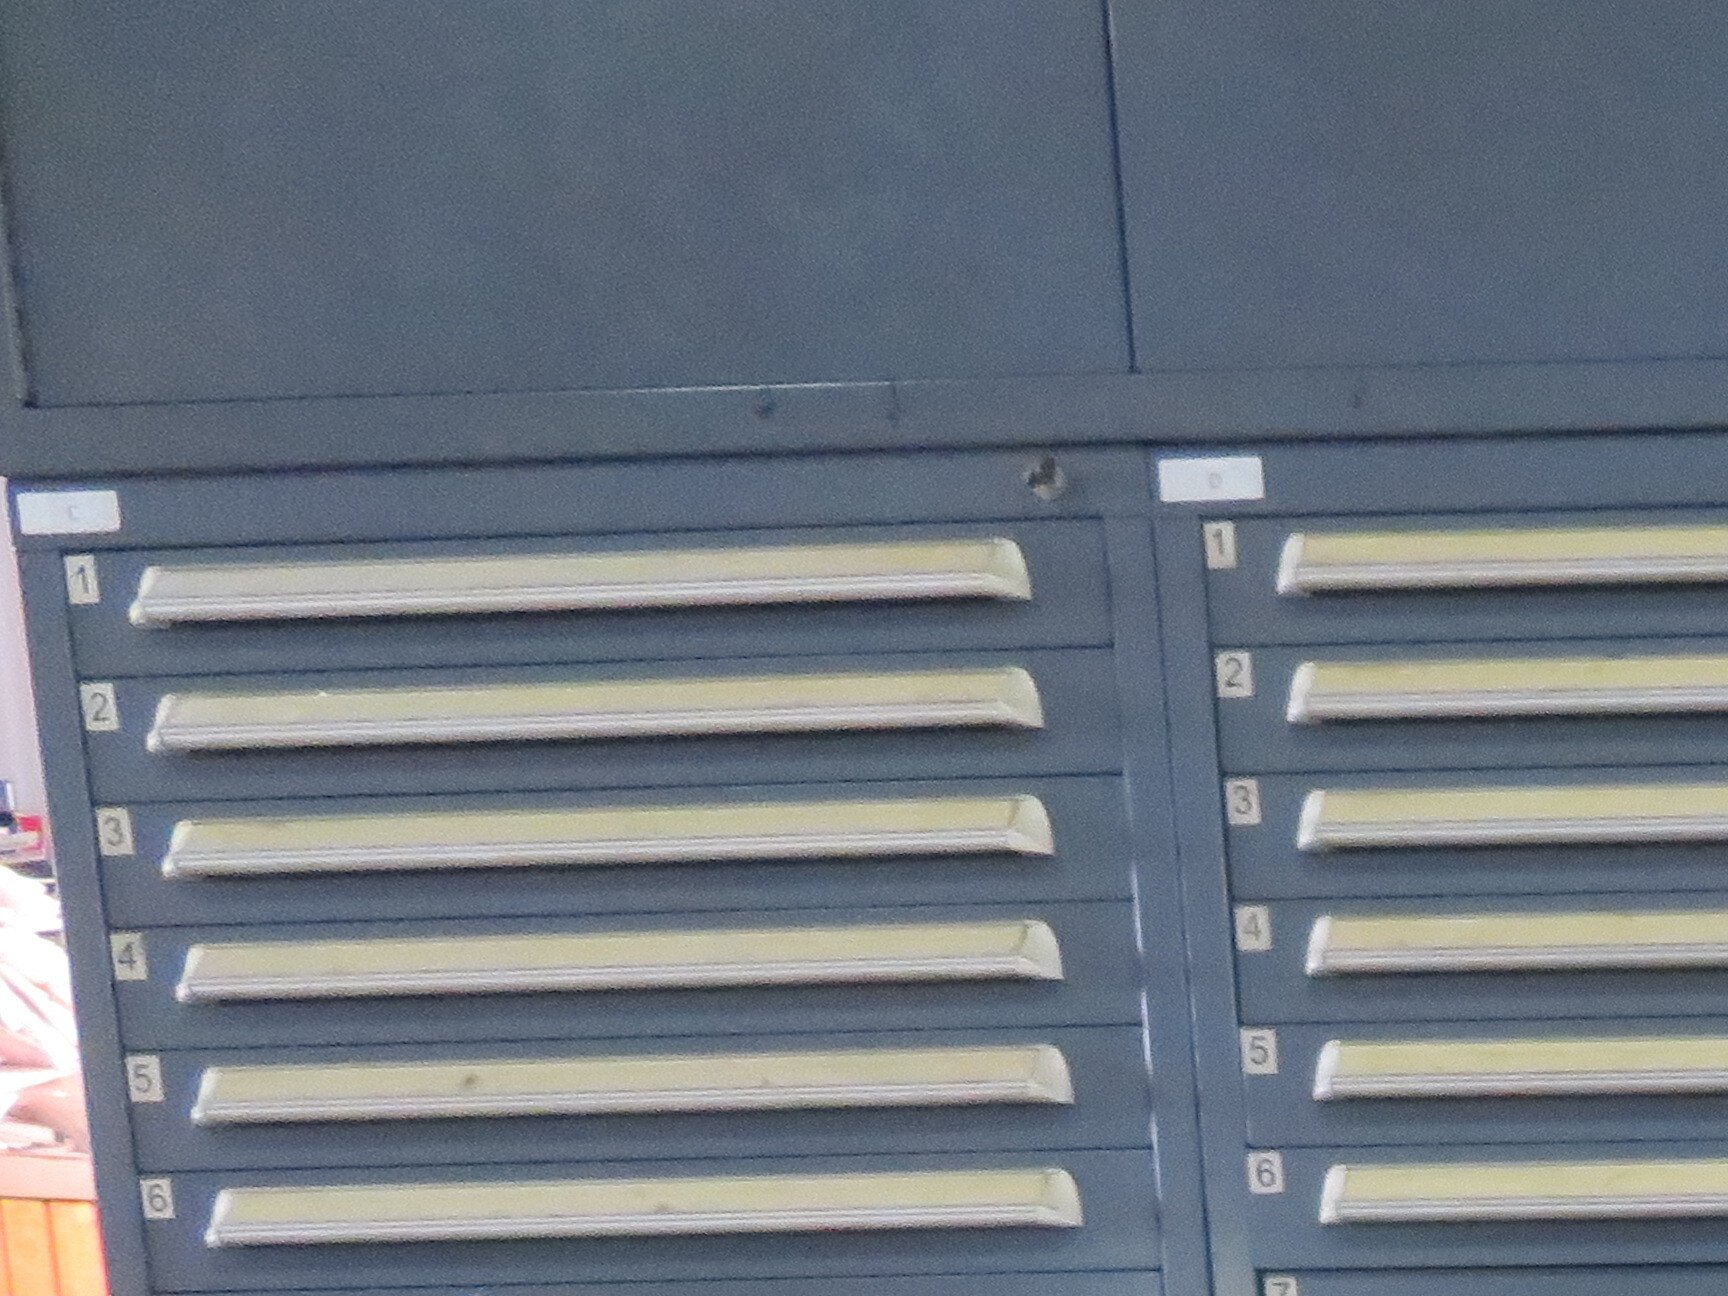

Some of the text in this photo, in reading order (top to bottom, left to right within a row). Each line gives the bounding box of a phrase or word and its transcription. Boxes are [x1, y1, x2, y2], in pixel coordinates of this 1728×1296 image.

[1213, 527, 1226, 555] 1
[76, 564, 90, 594] 1
[1225, 657, 1244, 688] 2
[91, 692, 110, 722] 2
[1234, 785, 1252, 815] 3
[104, 817, 124, 847] 3
[1242, 912, 1262, 943] 4
[117, 942, 138, 972] 4
[1249, 1036, 1269, 1066] 5
[132, 1064, 153, 1094] 5
[1256, 1158, 1277, 1187] 6
[149, 1183, 168, 1212] 6
